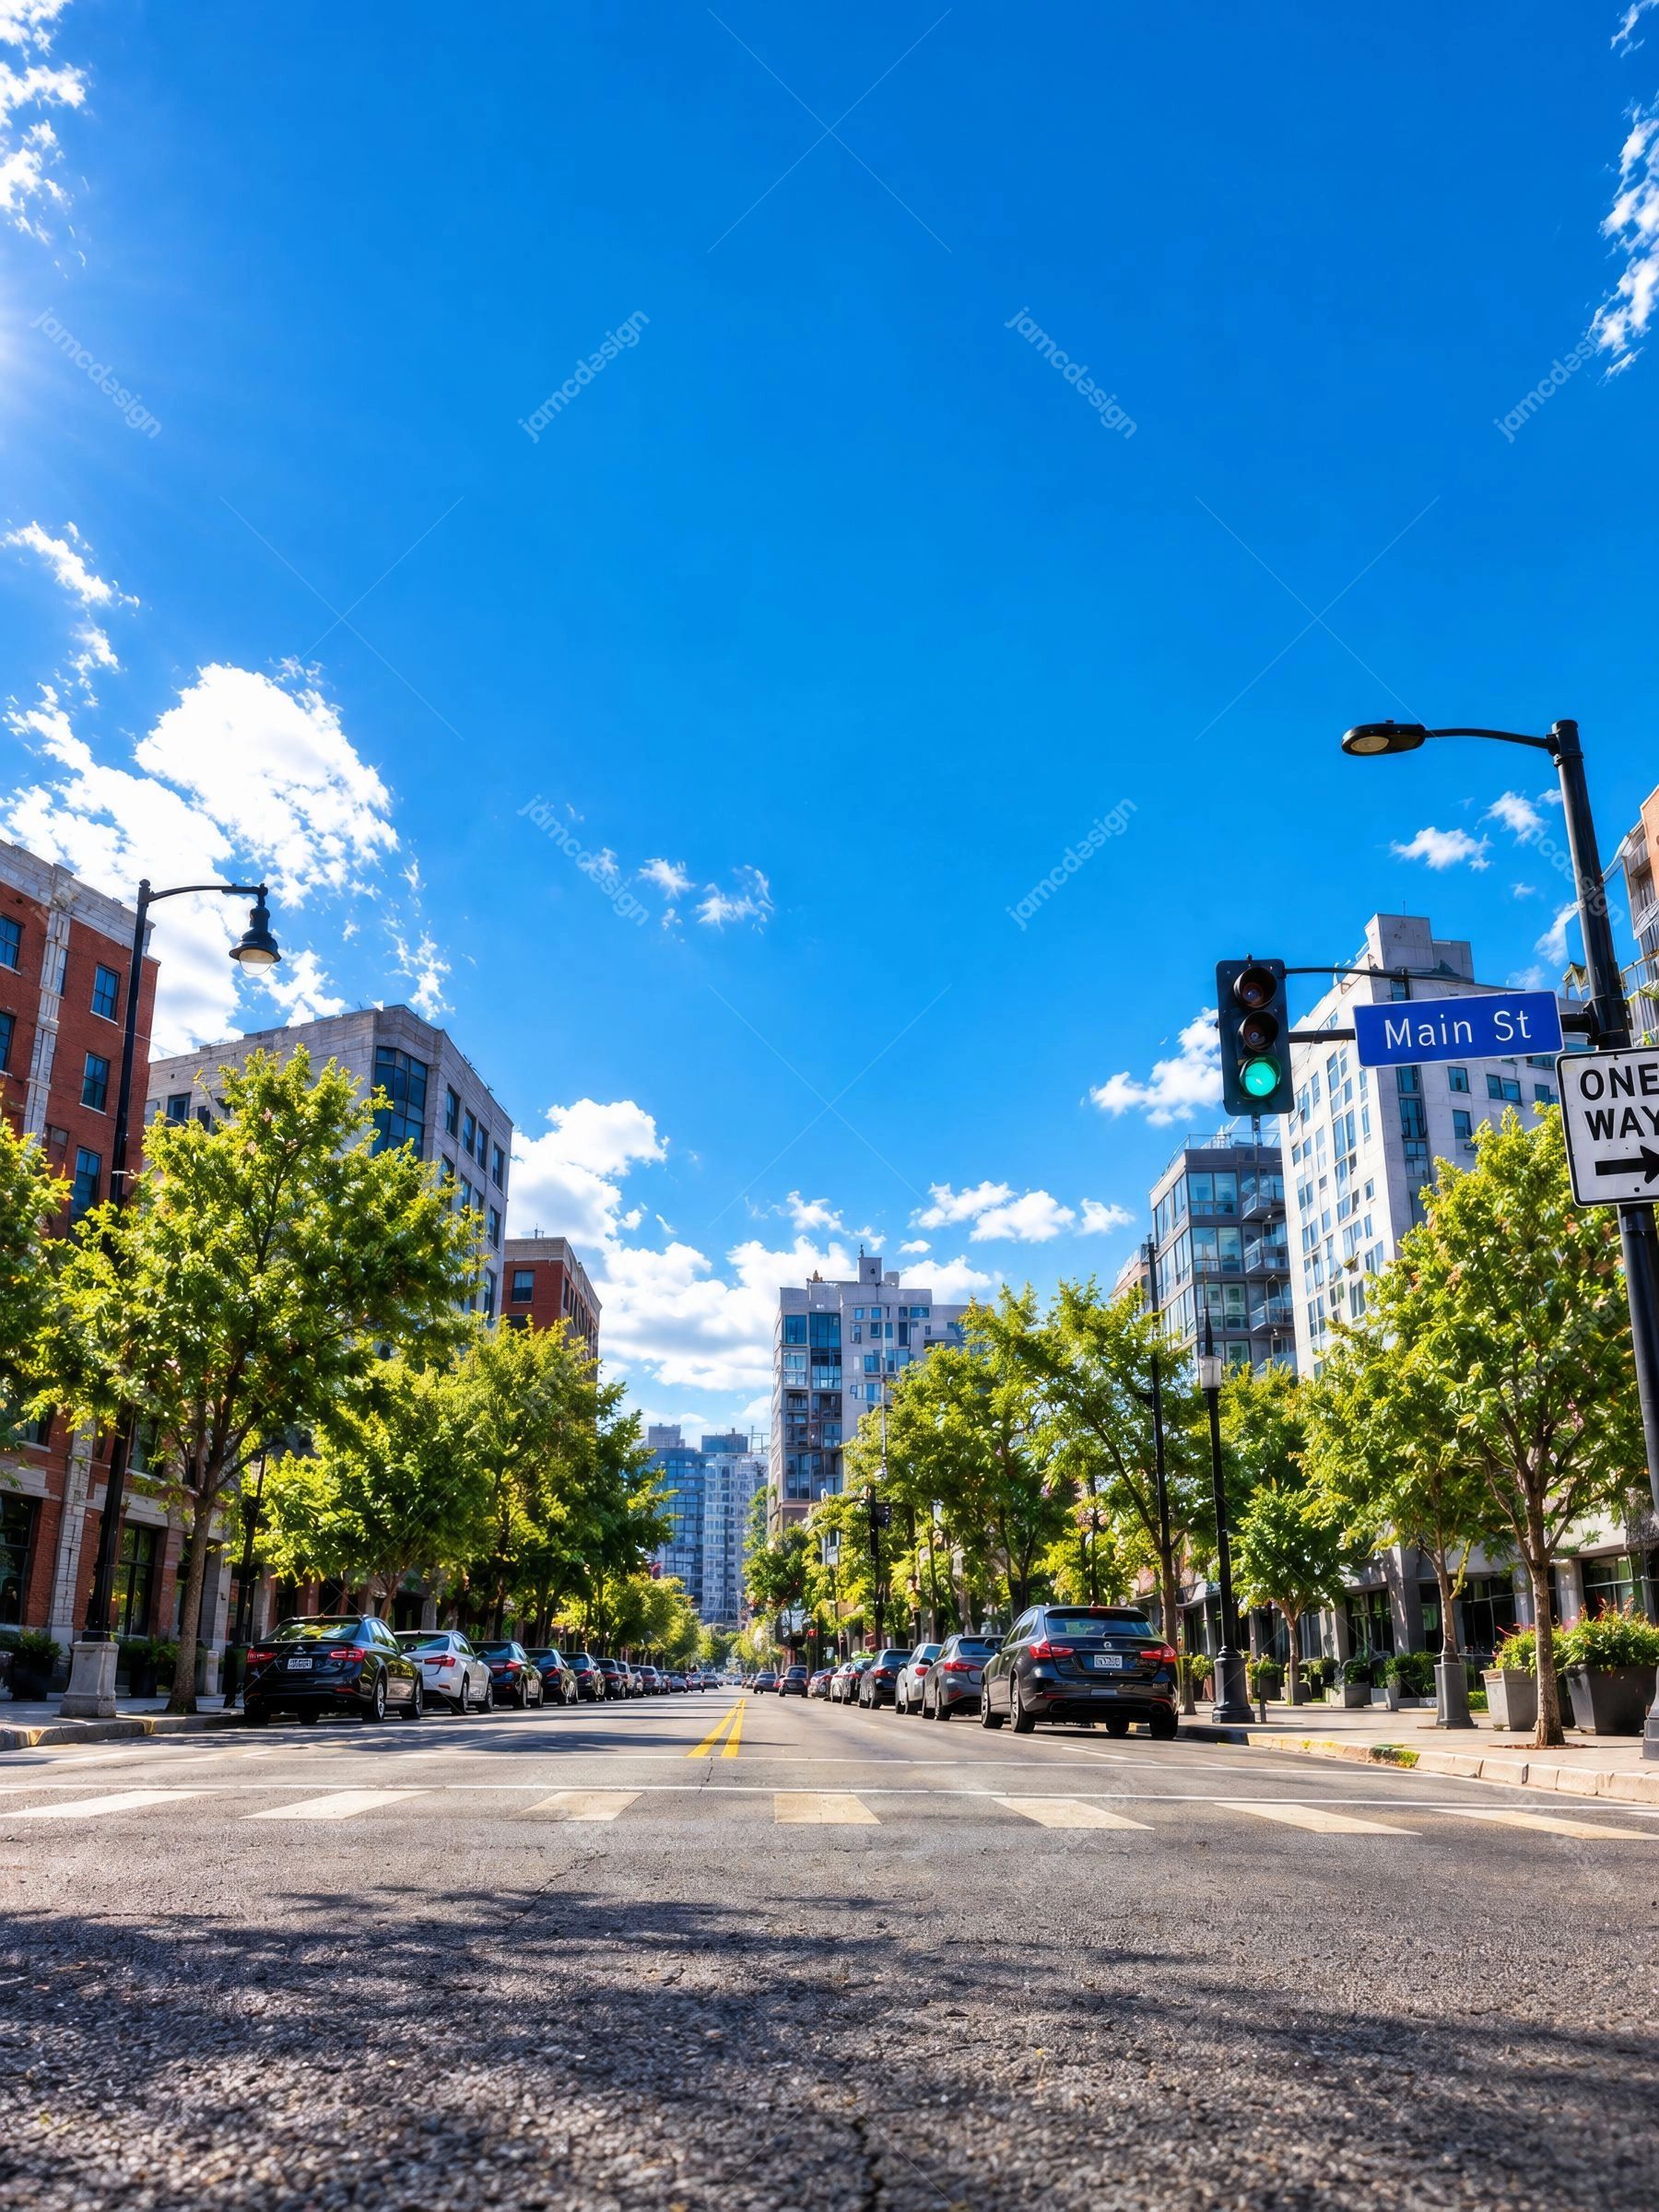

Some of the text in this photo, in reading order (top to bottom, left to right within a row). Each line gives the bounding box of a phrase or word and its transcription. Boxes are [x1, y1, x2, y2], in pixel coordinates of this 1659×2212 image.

[1384, 1009, 1532, 1050] Main St
[1580, 1063, 1659, 1100] ONE
[1583, 1105, 1659, 1141] WAY
